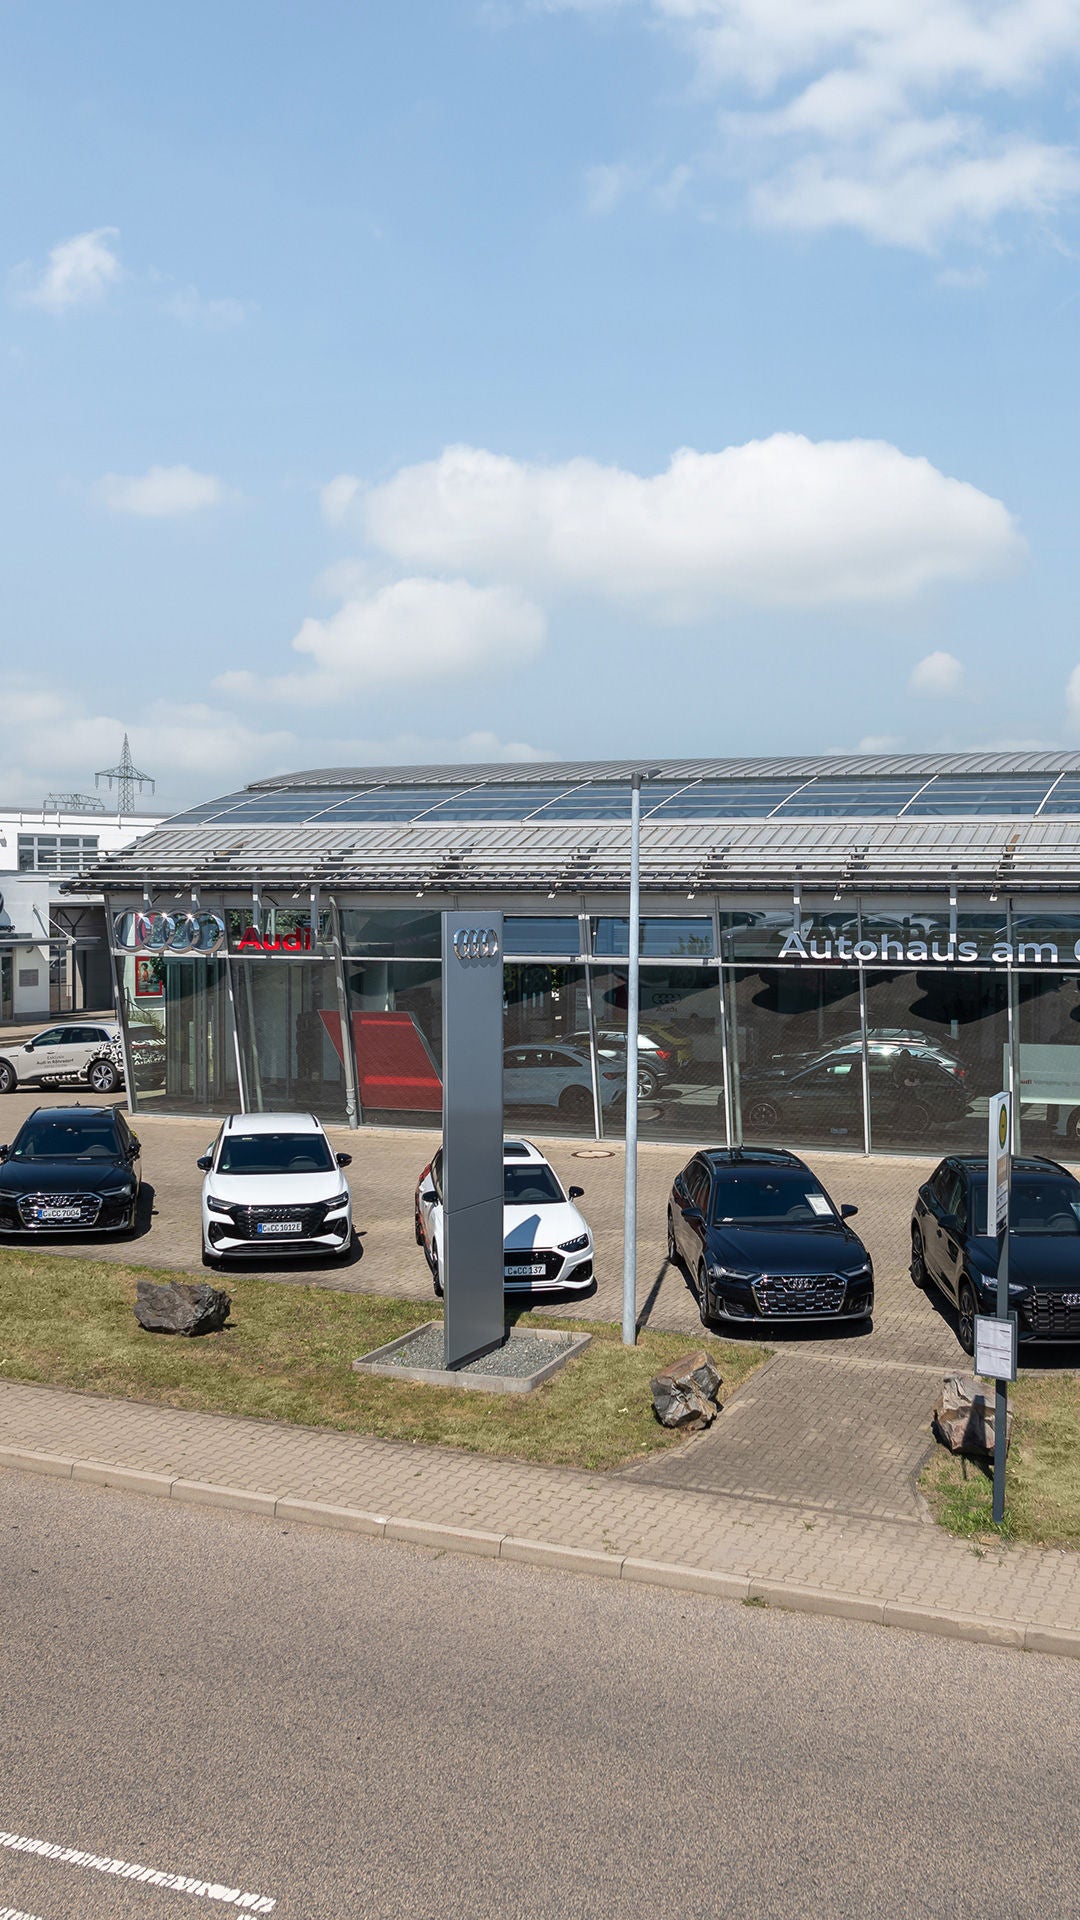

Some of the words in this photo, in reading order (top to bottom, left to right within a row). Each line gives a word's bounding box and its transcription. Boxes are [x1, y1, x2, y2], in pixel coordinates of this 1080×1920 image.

[237, 927, 311, 951] Audi
[778, 931, 979, 962] Autohaus
[991, 942, 1059, 963] am
